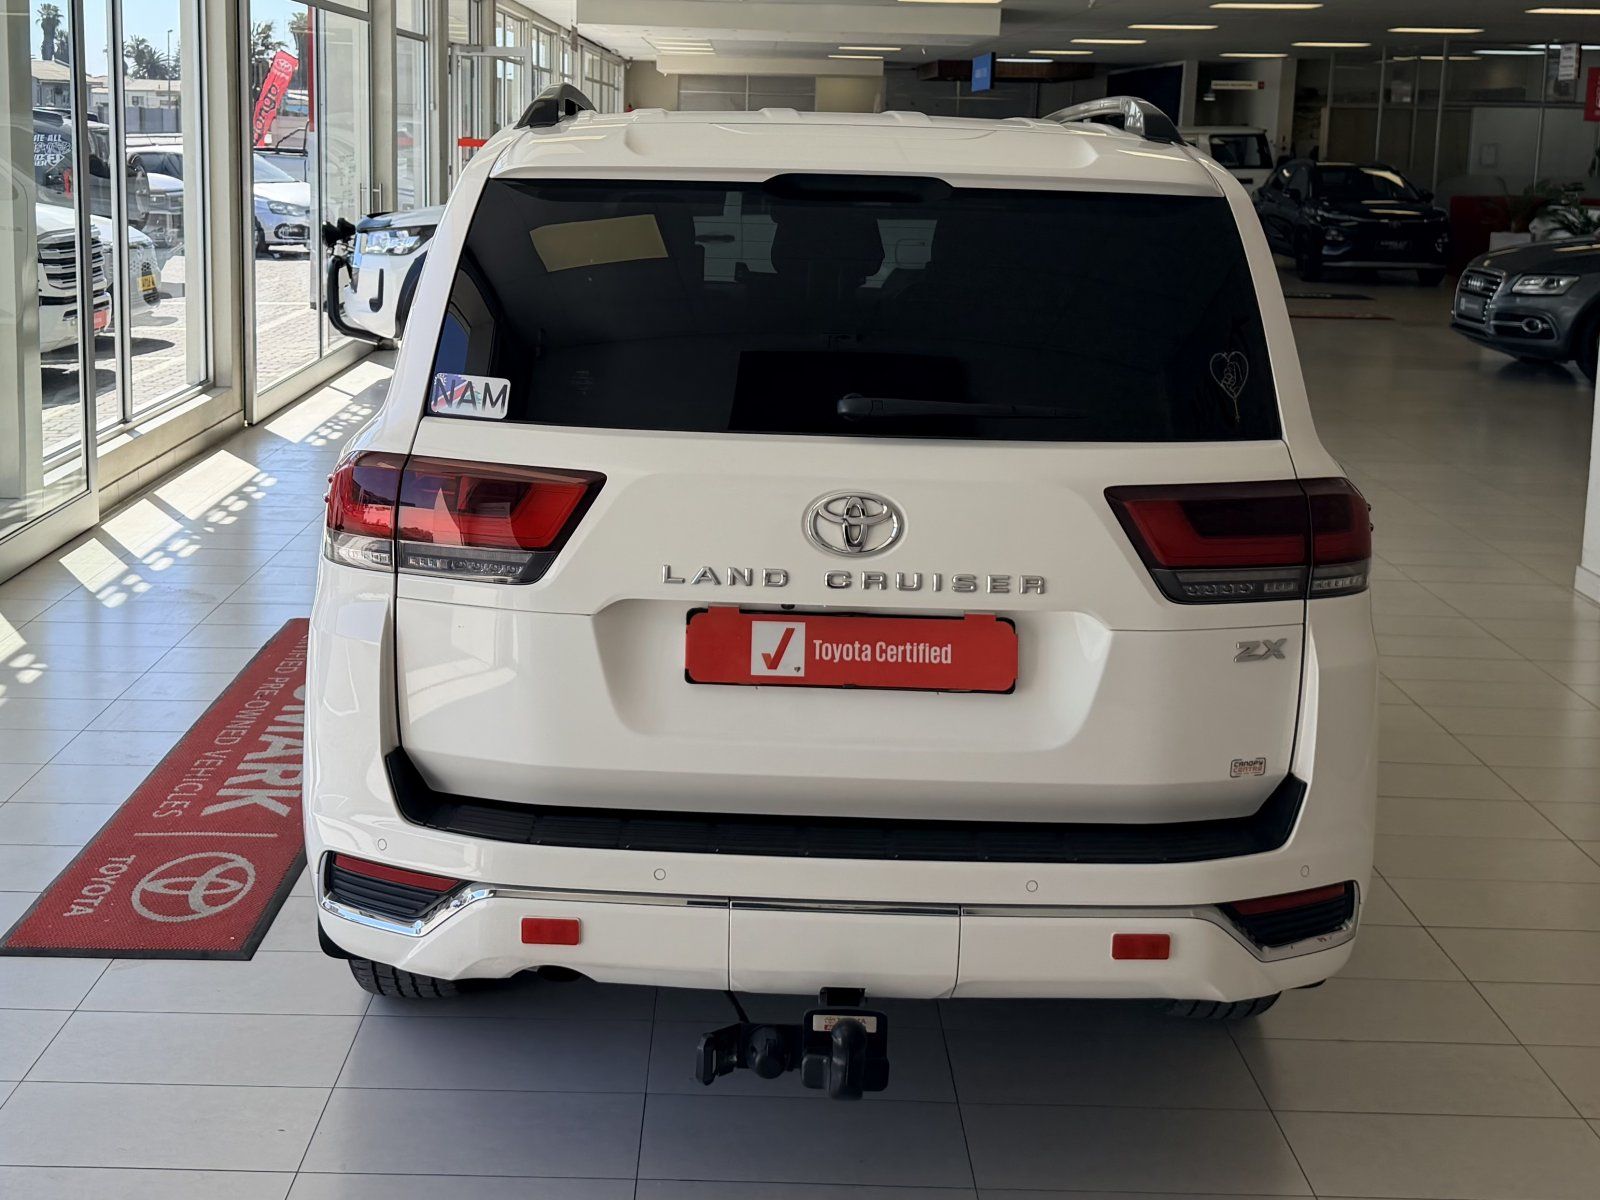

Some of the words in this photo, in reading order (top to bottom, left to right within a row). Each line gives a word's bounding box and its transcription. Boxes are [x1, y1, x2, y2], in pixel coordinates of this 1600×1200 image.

[433, 378, 508, 413] NAM
[662, 564, 790, 588] LAND
[824, 570, 1048, 594] CRUISER
[813, 639, 871, 664] Toyota
[876, 641, 952, 664] Certified
[1233, 638, 1287, 662] ZX
[213, 677, 290, 745] PRE-OWNED
[1233, 760, 1264, 768] CANOPY
[152, 749, 231, 818] VEHICLES
[63, 855, 136, 917] TOYOTA
